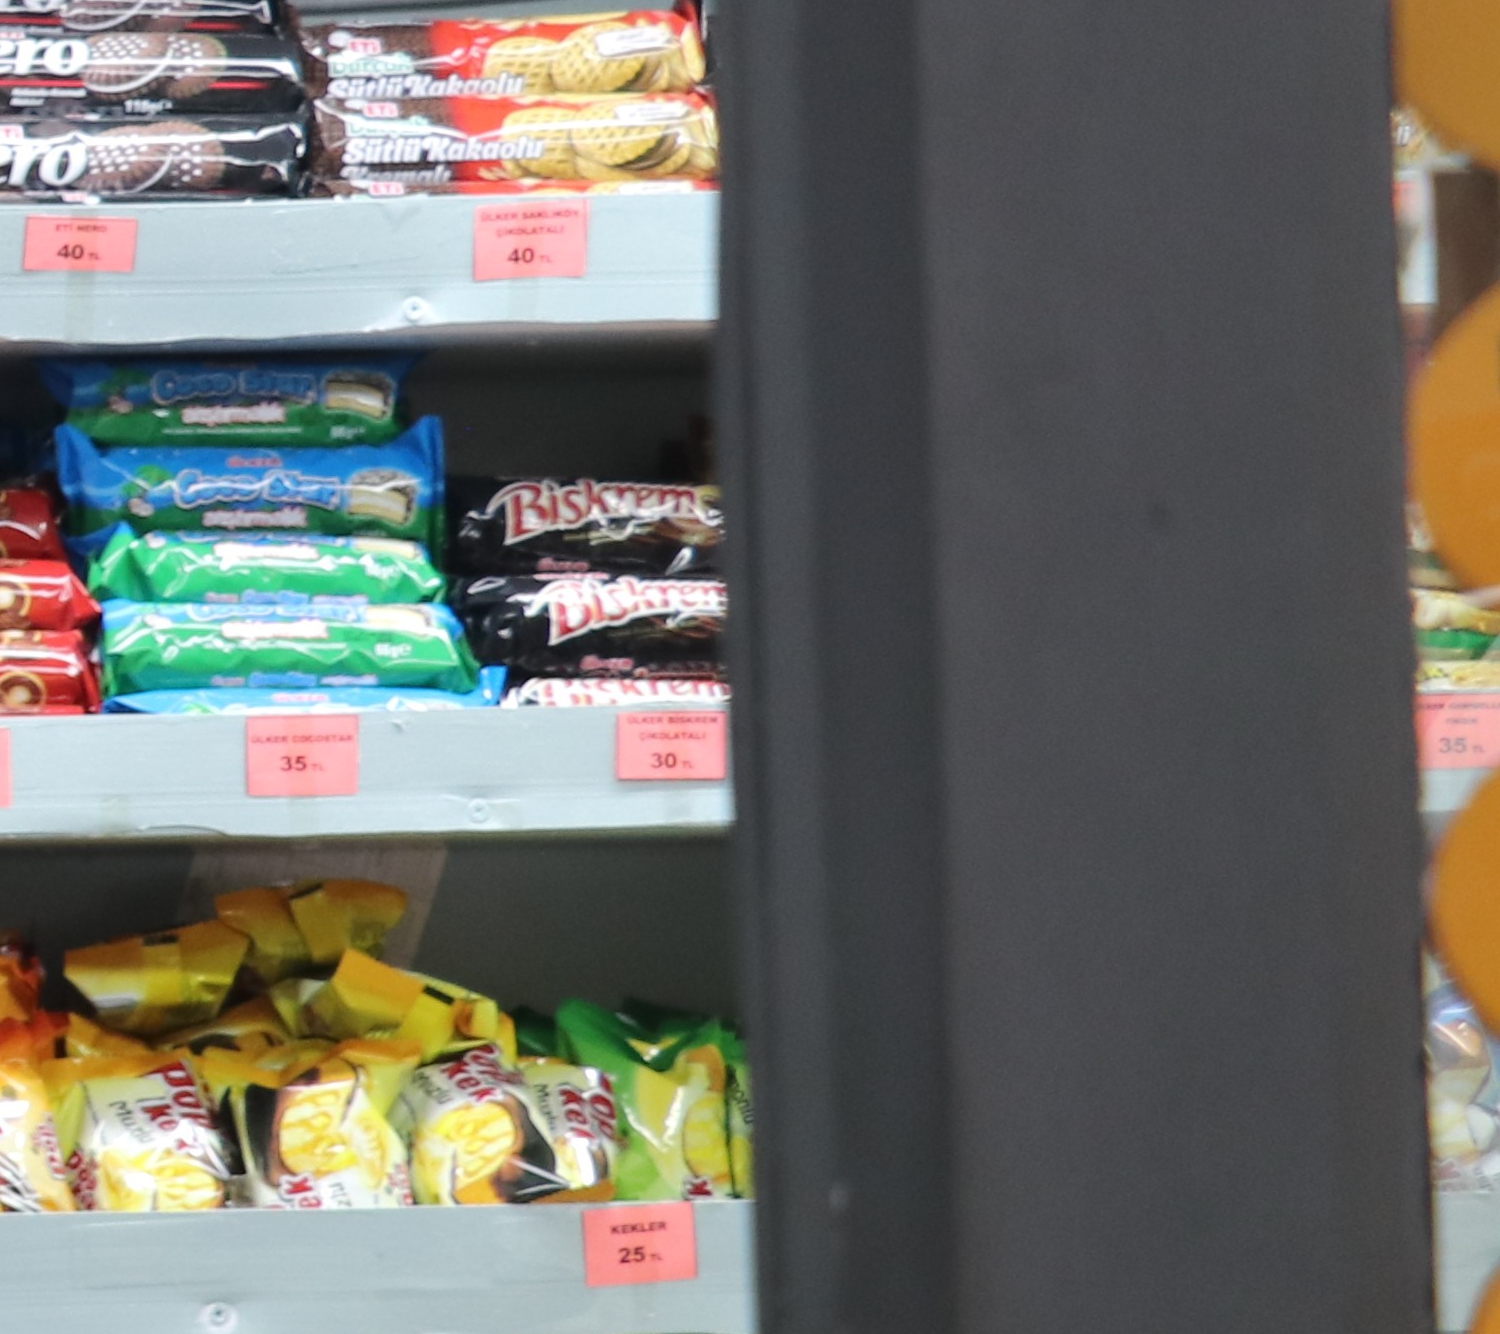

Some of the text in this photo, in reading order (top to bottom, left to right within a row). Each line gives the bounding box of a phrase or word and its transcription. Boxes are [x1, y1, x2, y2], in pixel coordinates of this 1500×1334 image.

[423, 136, 545, 160] Kakaolu
[58, 245, 84, 259] 40
[508, 248, 534, 263] 40
[1439, 737, 1468, 754] 35
[281, 756, 307, 772] 35
[651, 753, 676, 768] 30
[610, 1220, 667, 1234] KEKLER
[619, 1246, 646, 1265] 25
